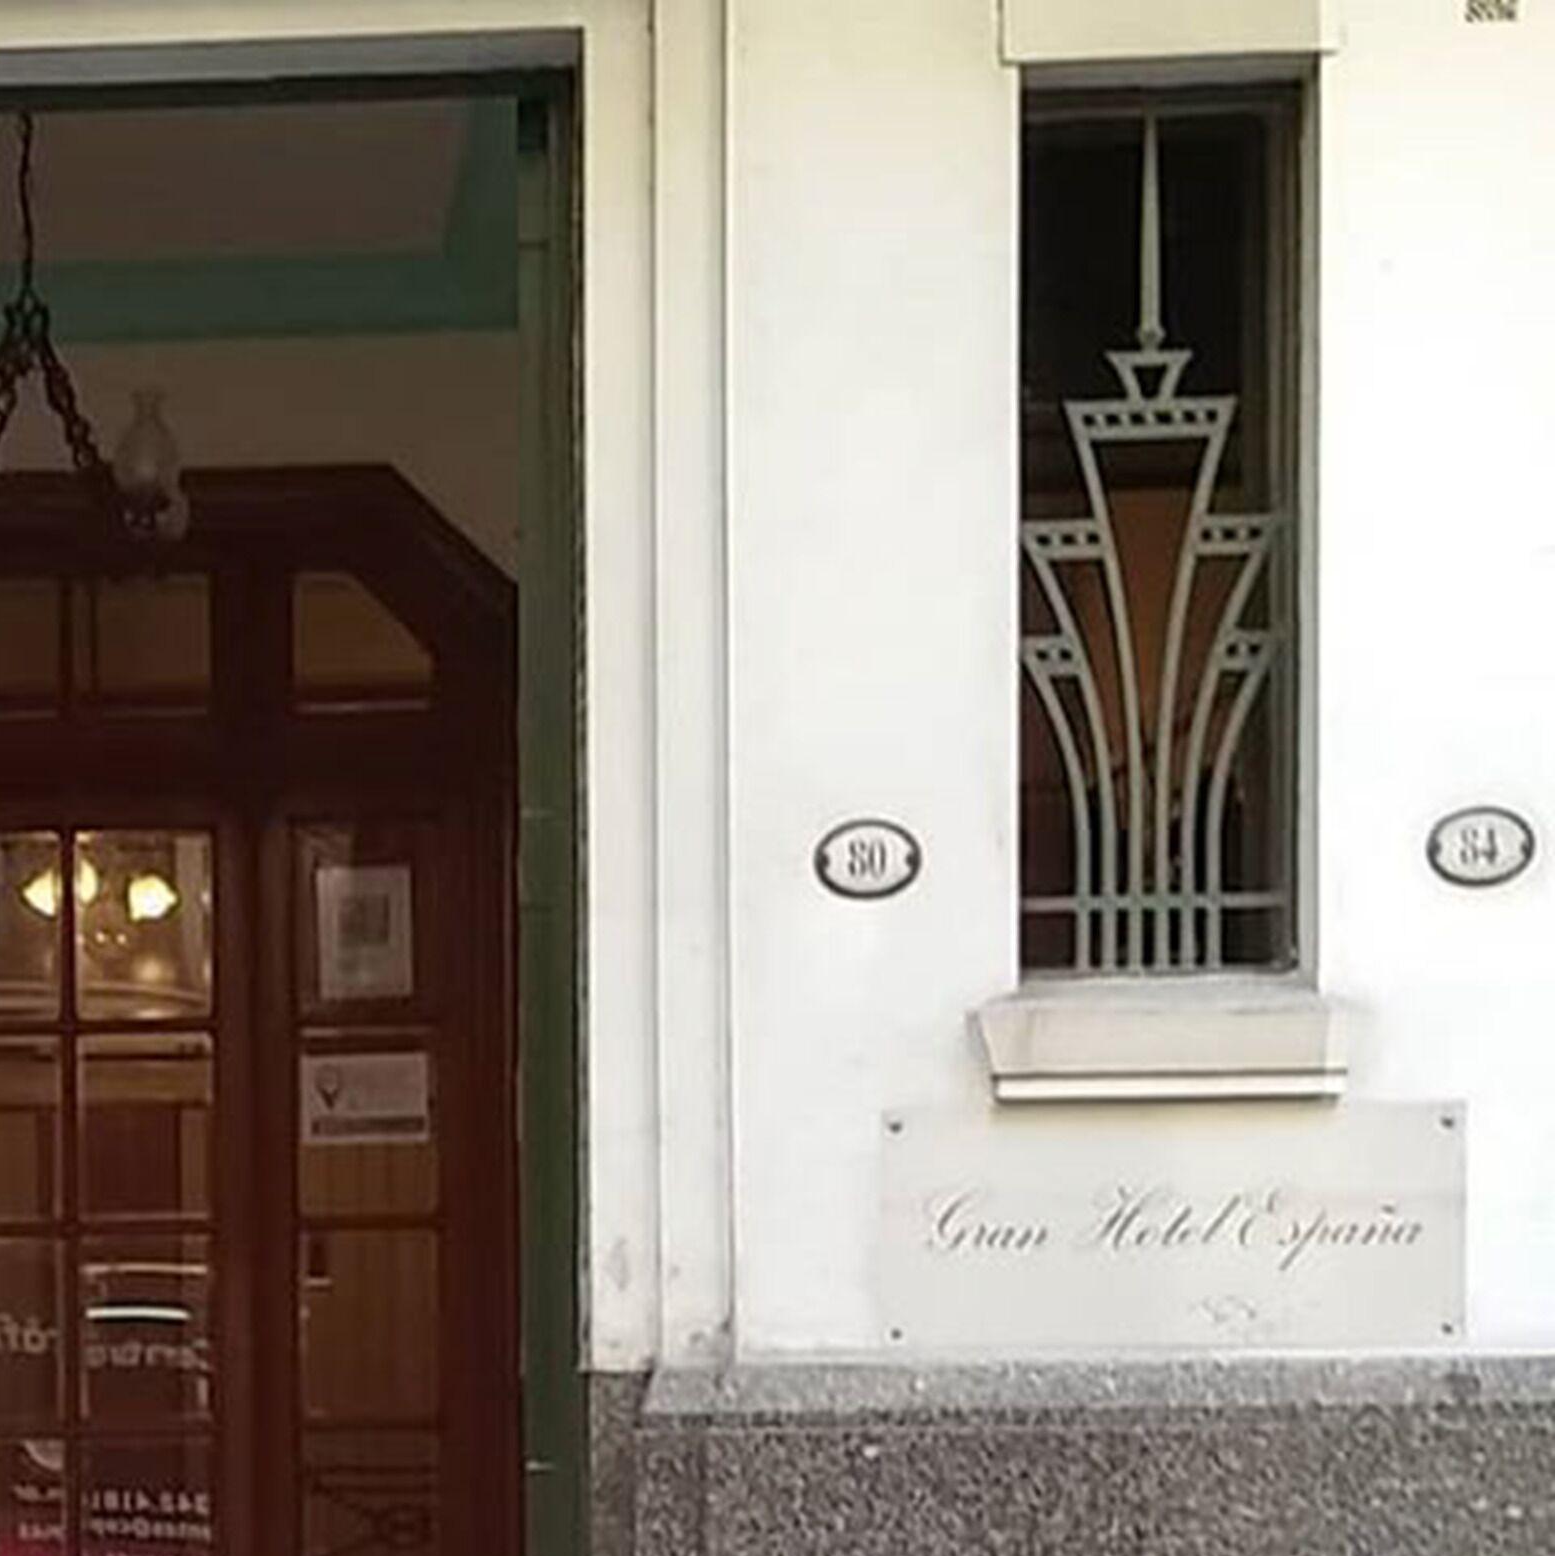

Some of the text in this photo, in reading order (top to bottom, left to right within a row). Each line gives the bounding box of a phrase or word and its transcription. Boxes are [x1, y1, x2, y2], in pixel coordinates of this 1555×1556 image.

[847, 839, 887, 881] 80
[1459, 826, 1499, 865] 84
[925, 1183, 1425, 1272] Gran Hotel España
